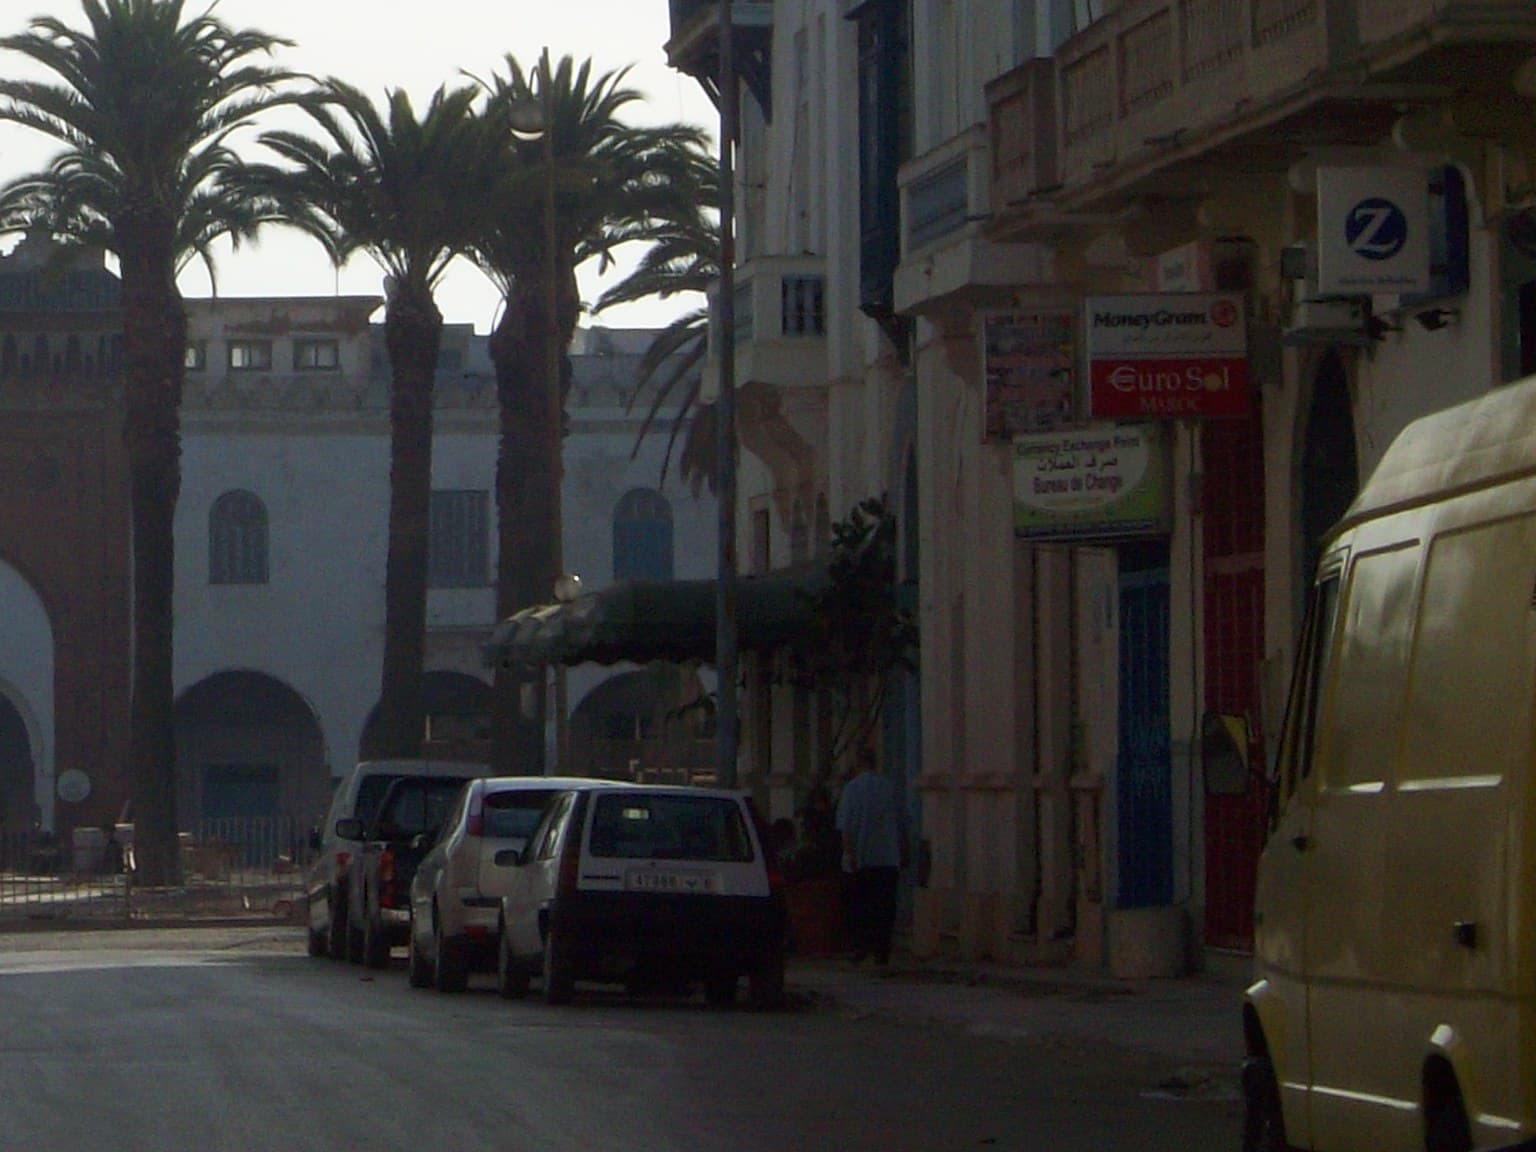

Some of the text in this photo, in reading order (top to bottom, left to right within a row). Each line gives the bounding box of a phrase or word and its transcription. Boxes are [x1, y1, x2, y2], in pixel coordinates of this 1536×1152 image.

[1350, 207, 1401, 255] Z
[1094, 310, 1207, 328] MoneyGram
[1034, 476, 1068, 494] Bureau
[1085, 473, 1123, 493] Change
